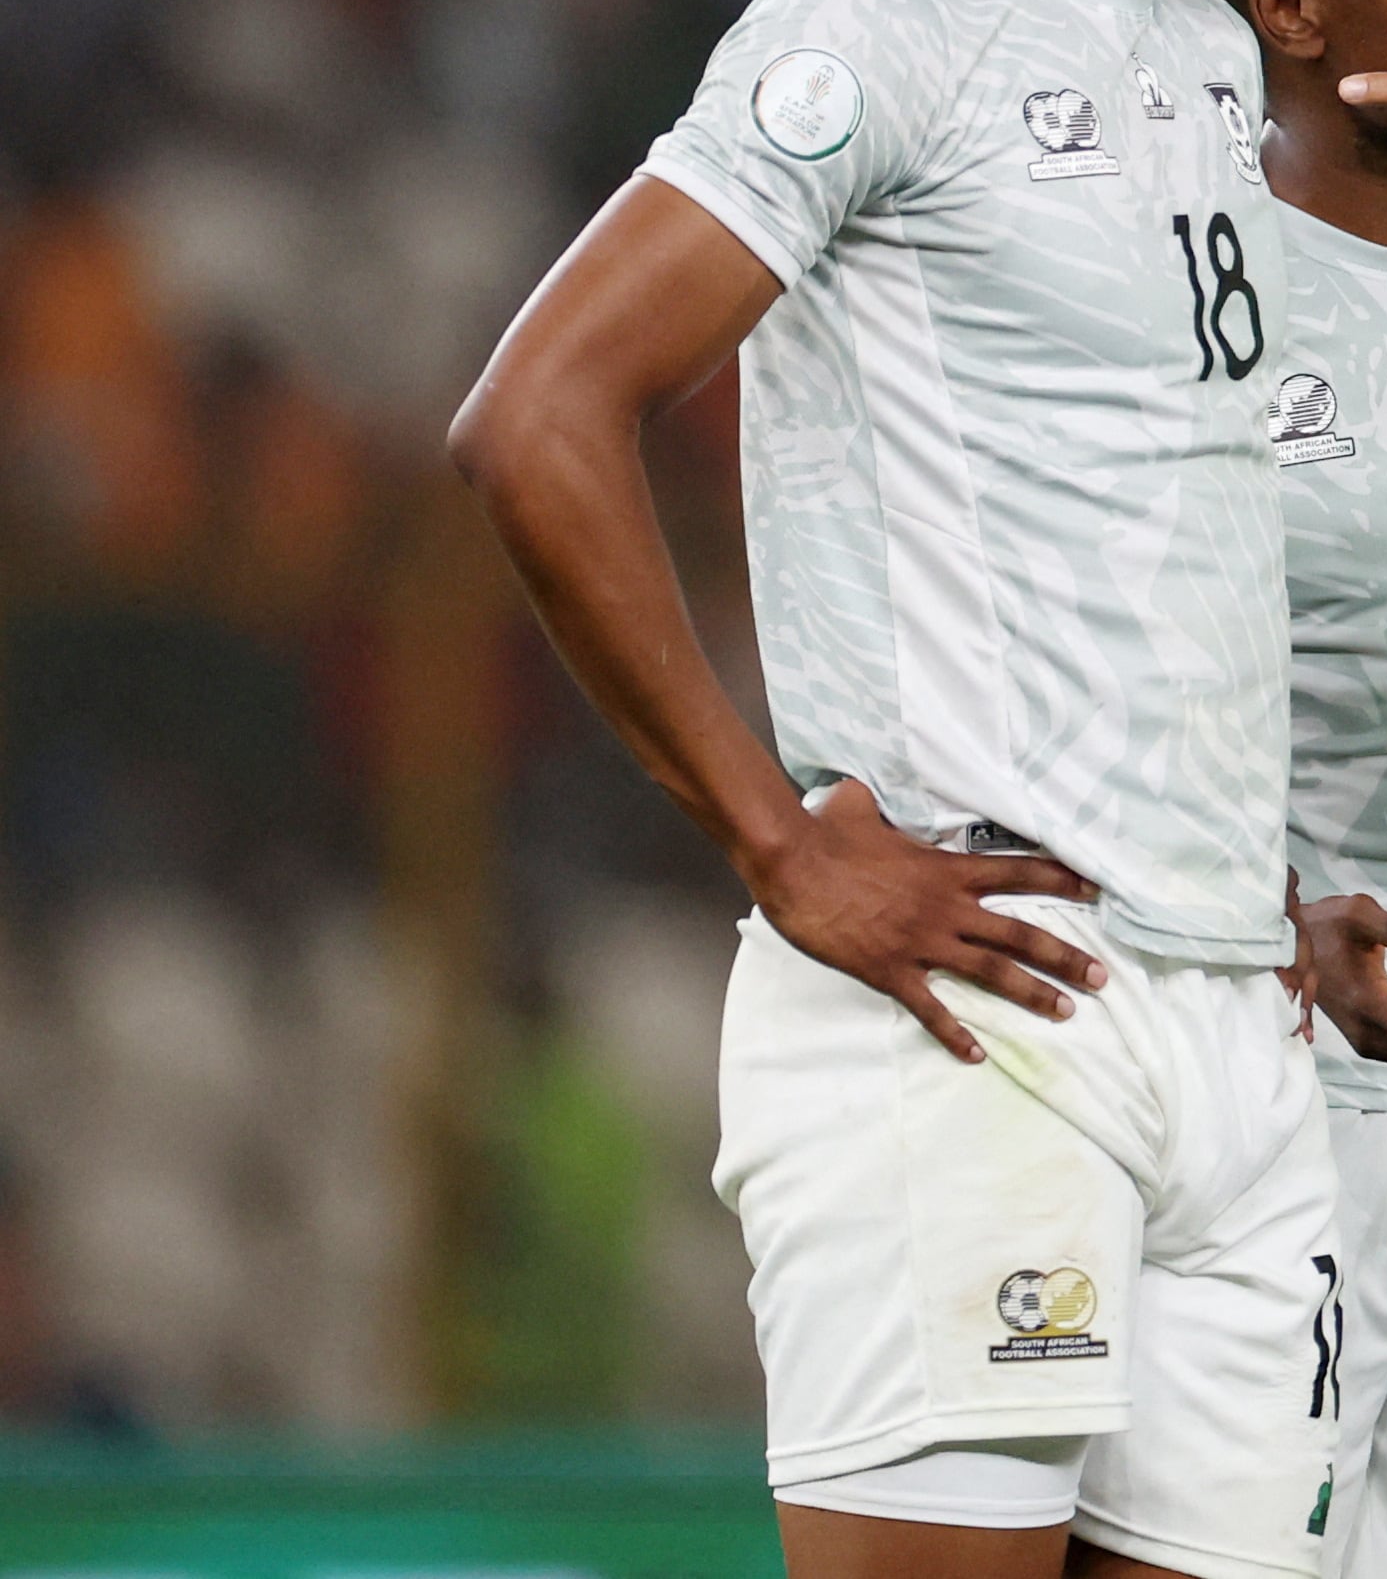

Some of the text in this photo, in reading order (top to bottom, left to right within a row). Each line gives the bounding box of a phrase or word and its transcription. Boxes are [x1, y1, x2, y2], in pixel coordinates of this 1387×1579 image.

[1173, 212, 1264, 381] 18
[1294, 438, 1332, 450] AFRICAN
[1294, 445, 1351, 460] ASSOCIATION
[1011, 1336, 1088, 1349] SOUTH AFRICAN
[992, 1346, 1105, 1359] FOOTBALL ASSOCIATION
